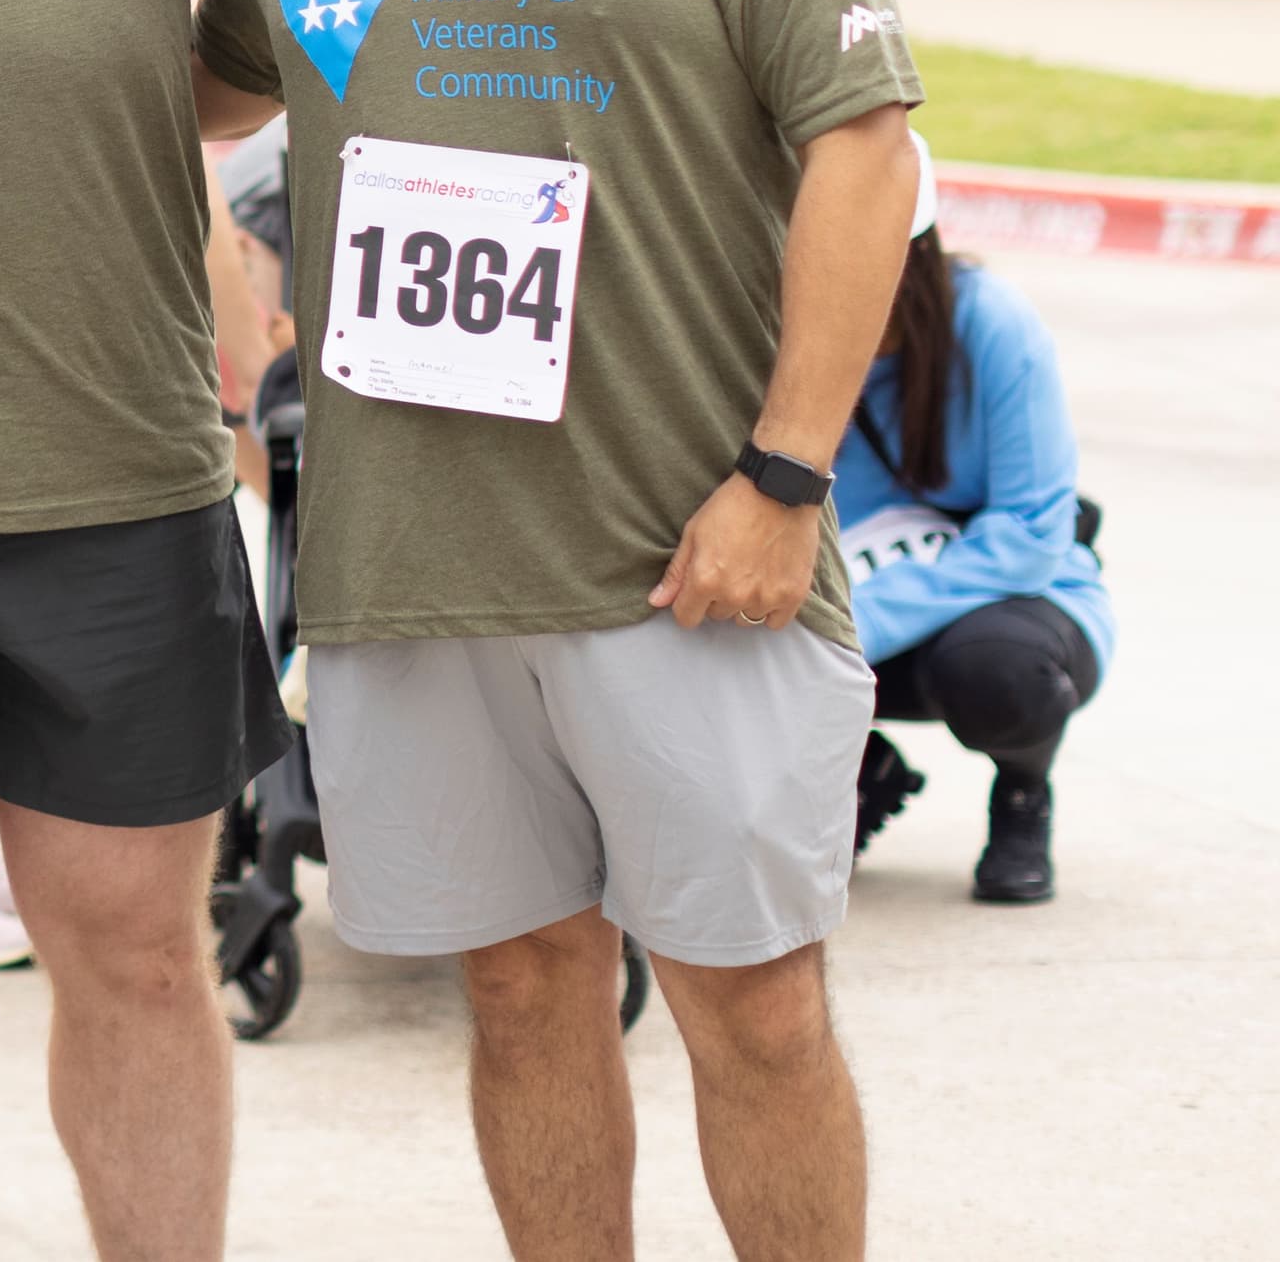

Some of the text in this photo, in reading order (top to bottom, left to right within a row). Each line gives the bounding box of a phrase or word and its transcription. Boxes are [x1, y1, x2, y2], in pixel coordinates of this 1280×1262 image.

[411, 17, 557, 51] Veterans
[415, 65, 616, 113] Community
[353, 170, 536, 211] dallasathletesracing
[349, 225, 562, 342] 1364
